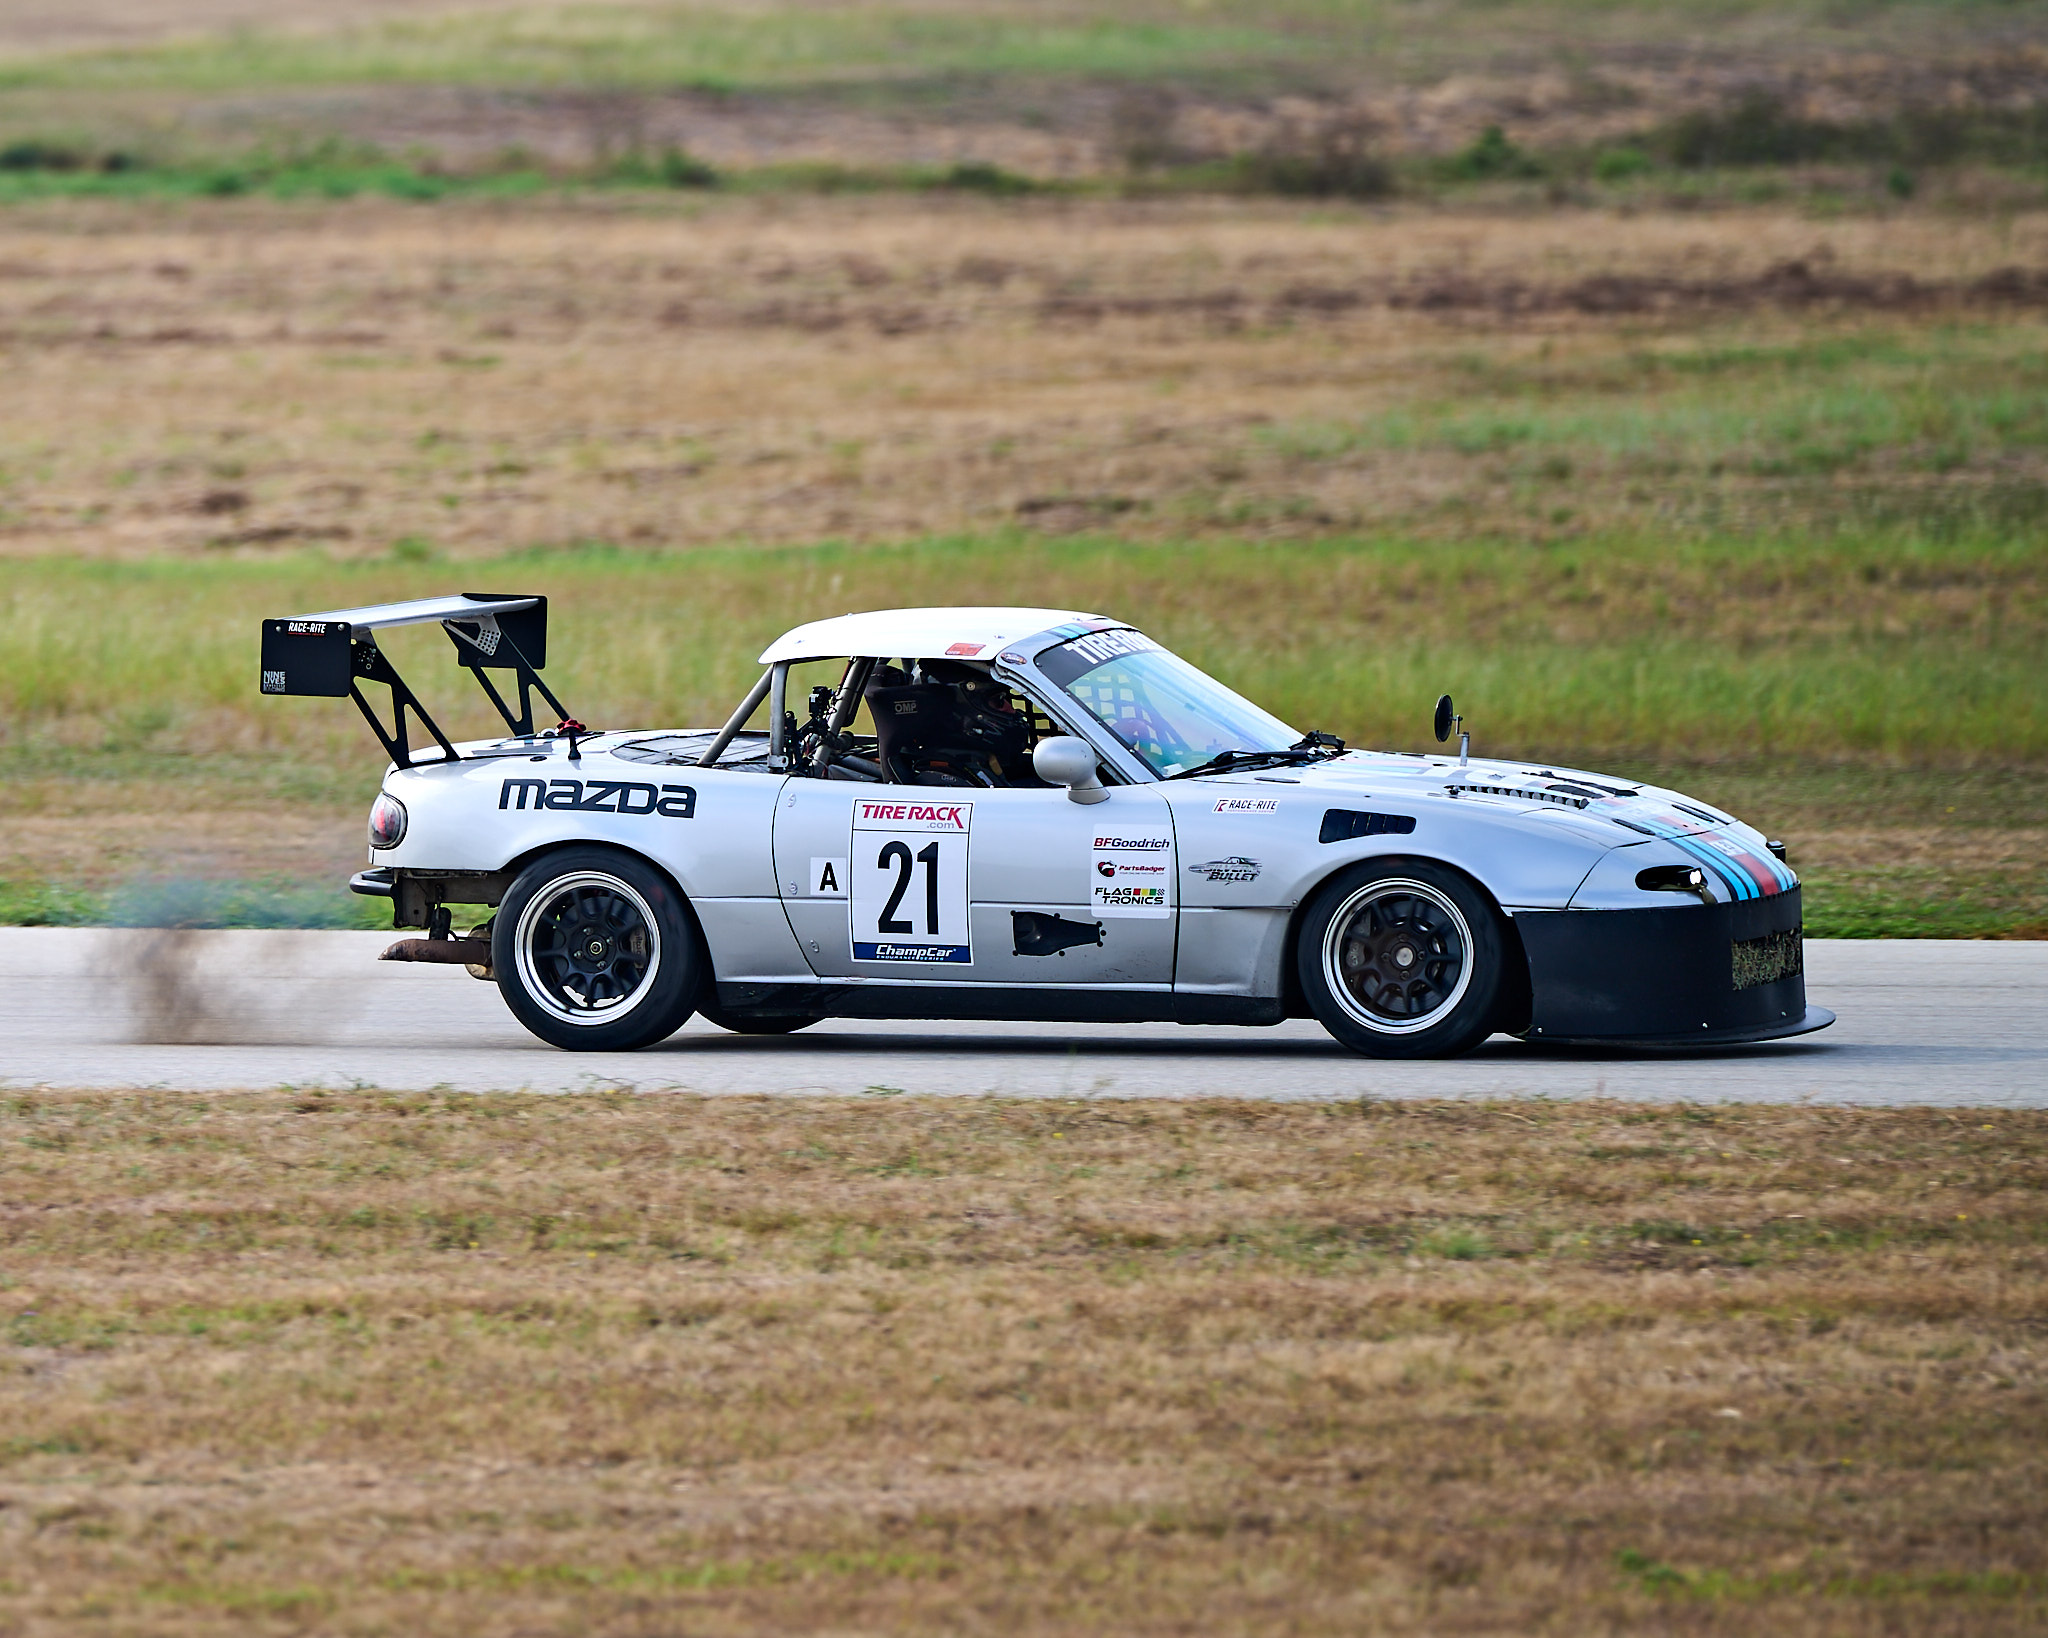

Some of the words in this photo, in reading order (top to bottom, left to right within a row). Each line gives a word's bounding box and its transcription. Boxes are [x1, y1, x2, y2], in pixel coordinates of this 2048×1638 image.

[288, 622, 326, 633] RACE-RITE
[263, 670, 286, 678] NINE
[263, 677, 286, 685] LIVES
[894, 702, 917, 713] OMP
[1228, 799, 1278, 810] RACE-RITE
[862, 804, 907, 820] TIRE
[907, 805, 964, 829] RACK
[1093, 837, 1170, 848] BFGoodrich
[1118, 865, 1166, 873] PartsBadger
[819, 861, 839, 891] A
[1207, 871, 1258, 881] BULLET
[878, 840, 939, 935] 21
[1094, 887, 1132, 896] FLAG
[1101, 895, 1164, 905] TRONICS
[876, 944, 953, 960] ChampCar
